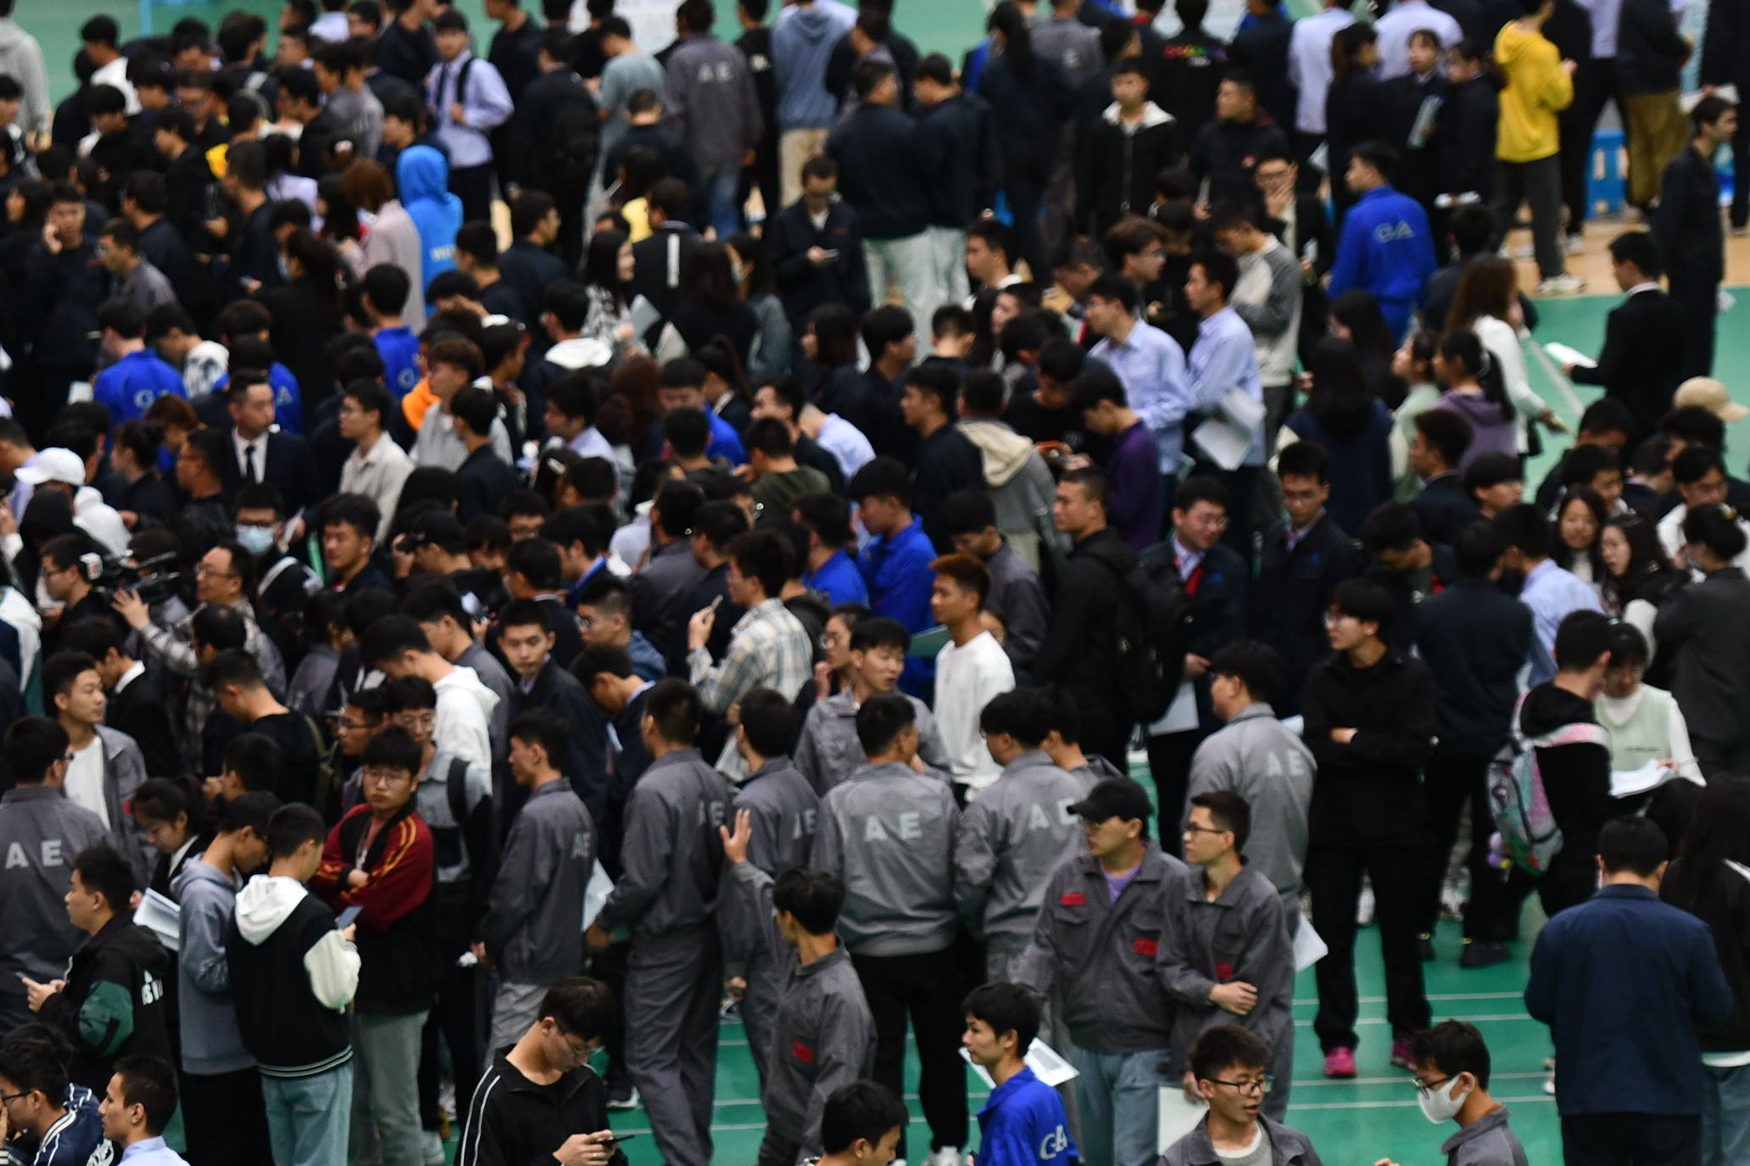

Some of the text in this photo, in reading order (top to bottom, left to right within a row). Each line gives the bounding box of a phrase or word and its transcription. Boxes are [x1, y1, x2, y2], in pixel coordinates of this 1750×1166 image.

[1266, 750, 1305, 776] AE
[864, 812, 922, 841] AE
[5, 840, 64, 869] AE
